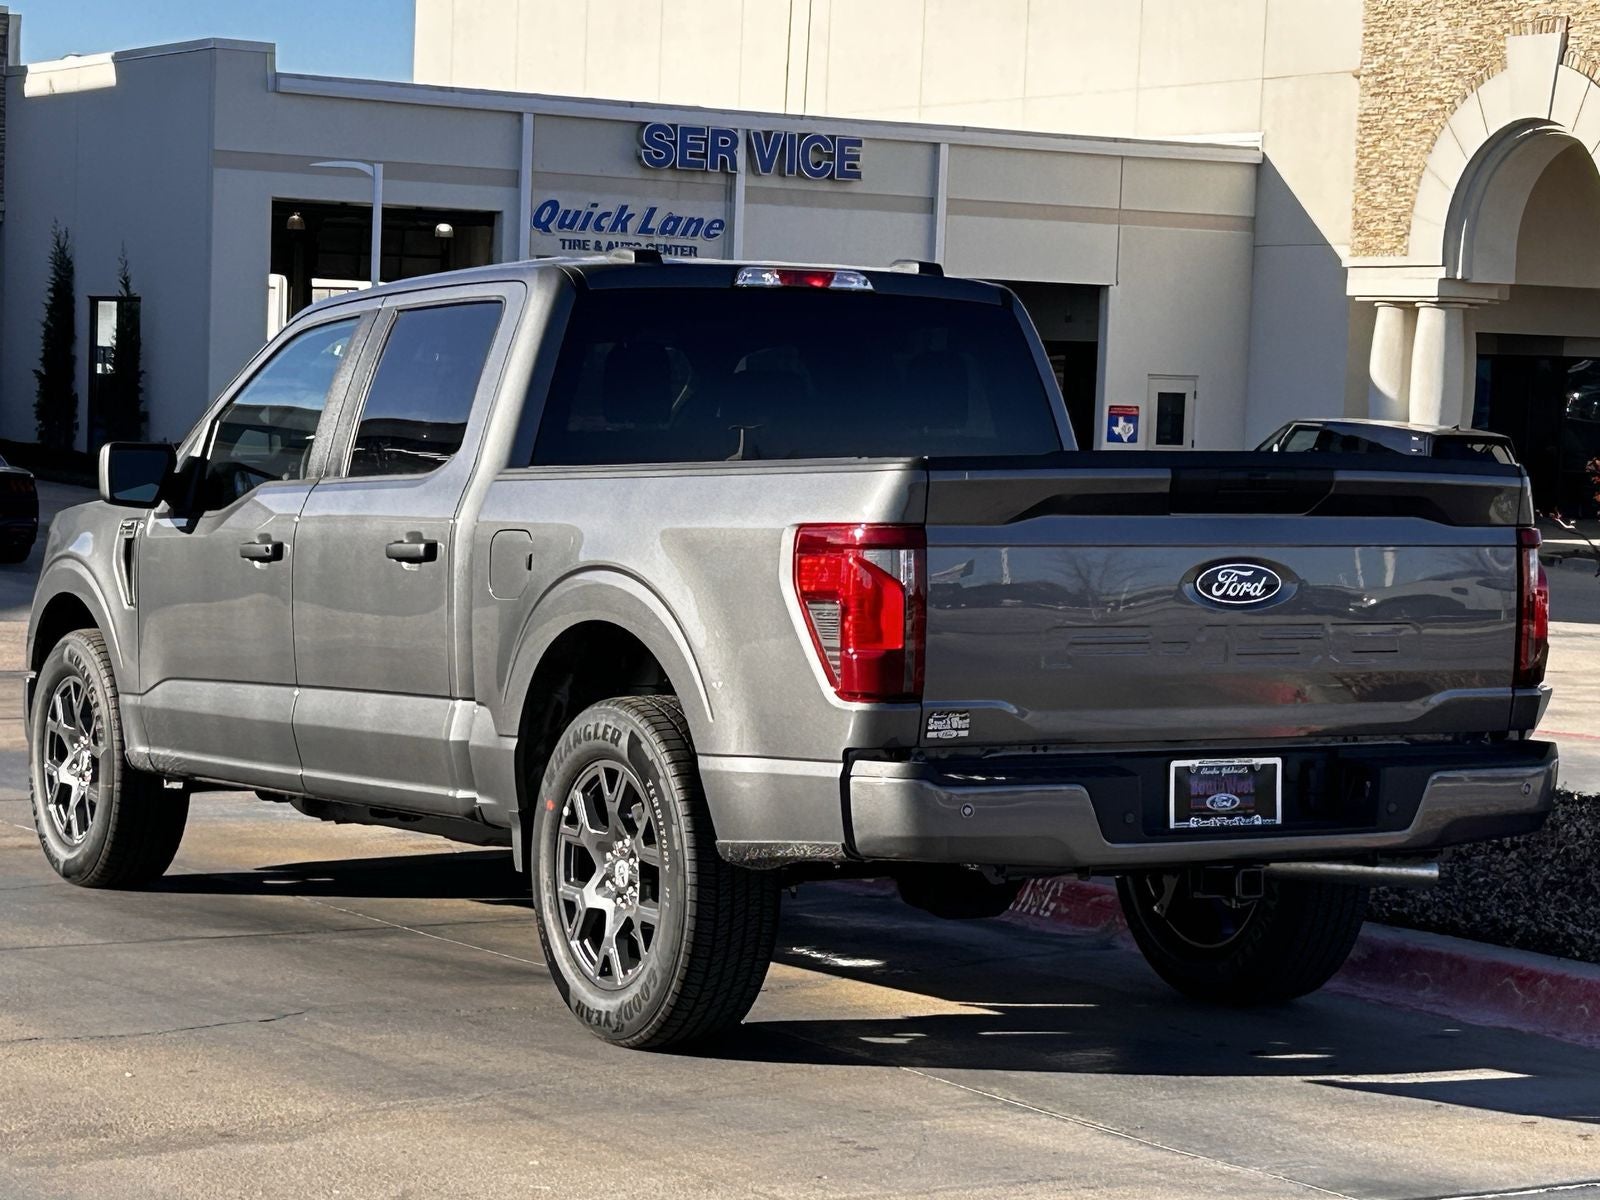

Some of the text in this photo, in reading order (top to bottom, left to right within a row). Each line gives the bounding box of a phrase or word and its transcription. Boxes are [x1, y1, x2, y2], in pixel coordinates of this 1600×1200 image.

[531, 198, 726, 241] Quick Lane
[559, 238, 591, 251] TIRE
[594, 240, 603, 252] &
[1211, 568, 1268, 597] Ford
